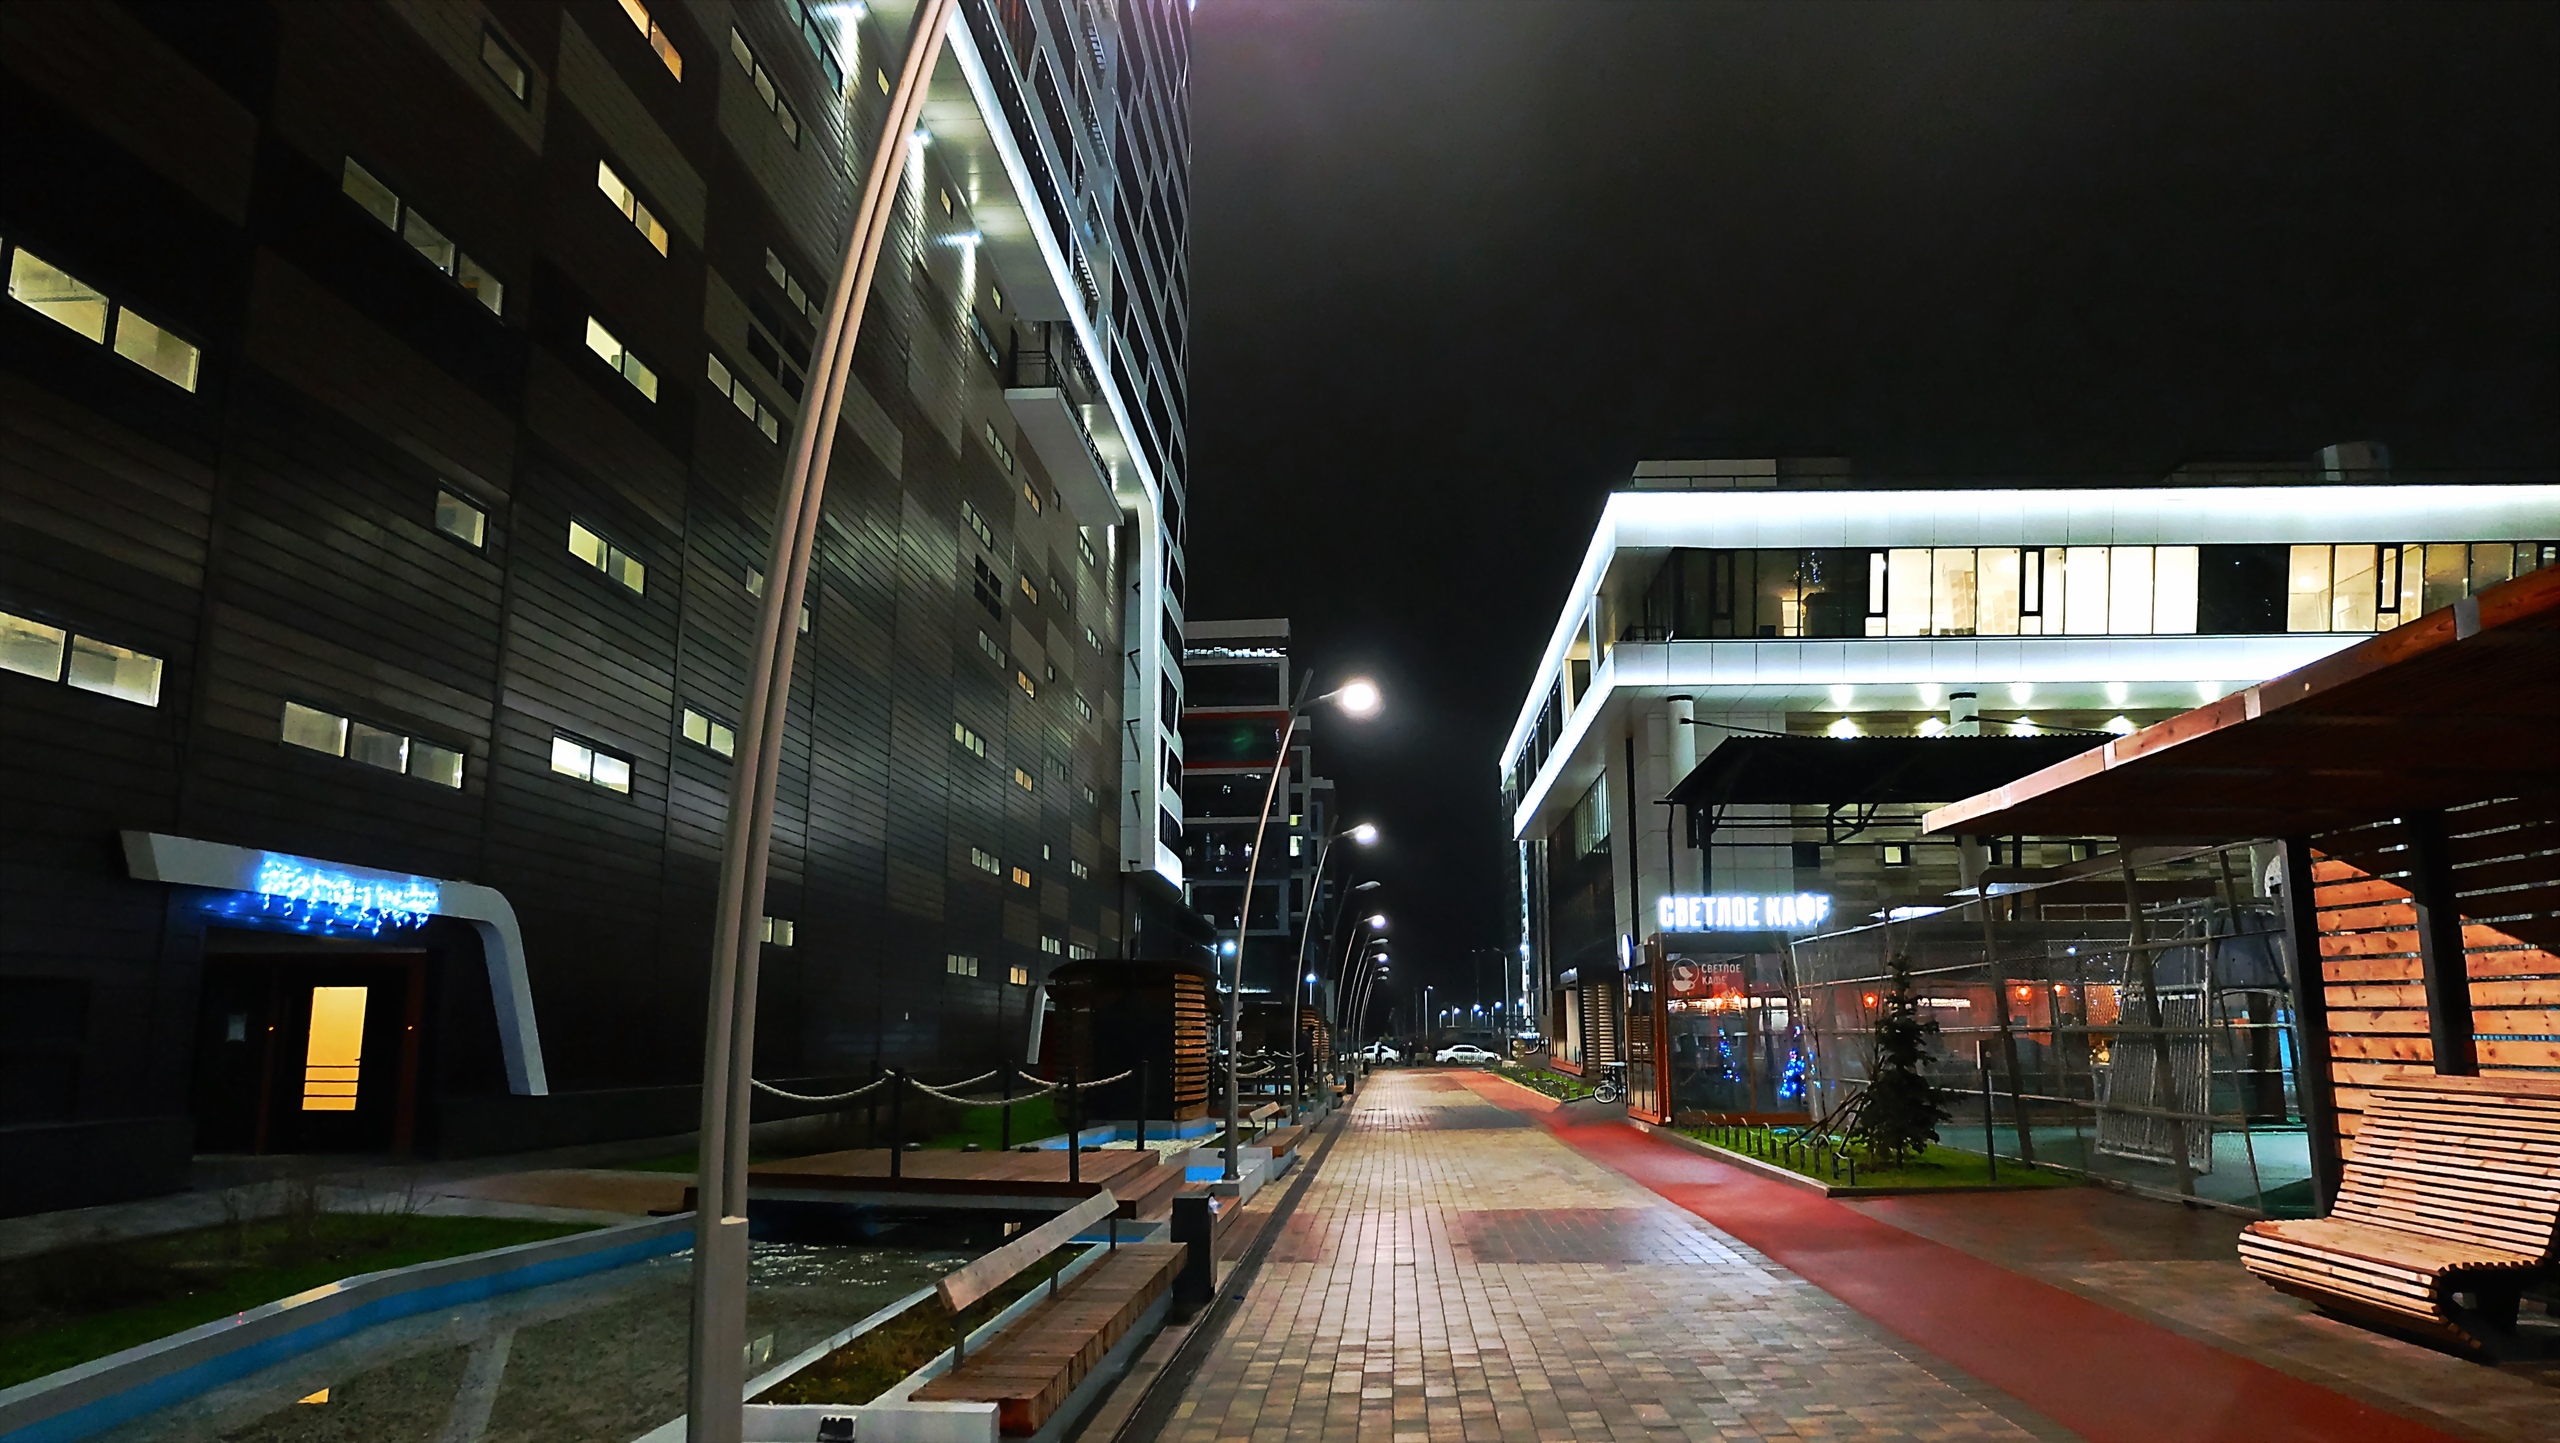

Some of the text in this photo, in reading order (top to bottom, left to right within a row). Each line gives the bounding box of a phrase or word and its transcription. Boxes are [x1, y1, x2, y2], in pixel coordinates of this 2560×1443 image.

[1659, 896, 1760, 927] СВЕТЛОЕ
[1701, 963, 1741, 974] СВЕТЛОЕ
[1701, 975, 1728, 985] КАФЕ
